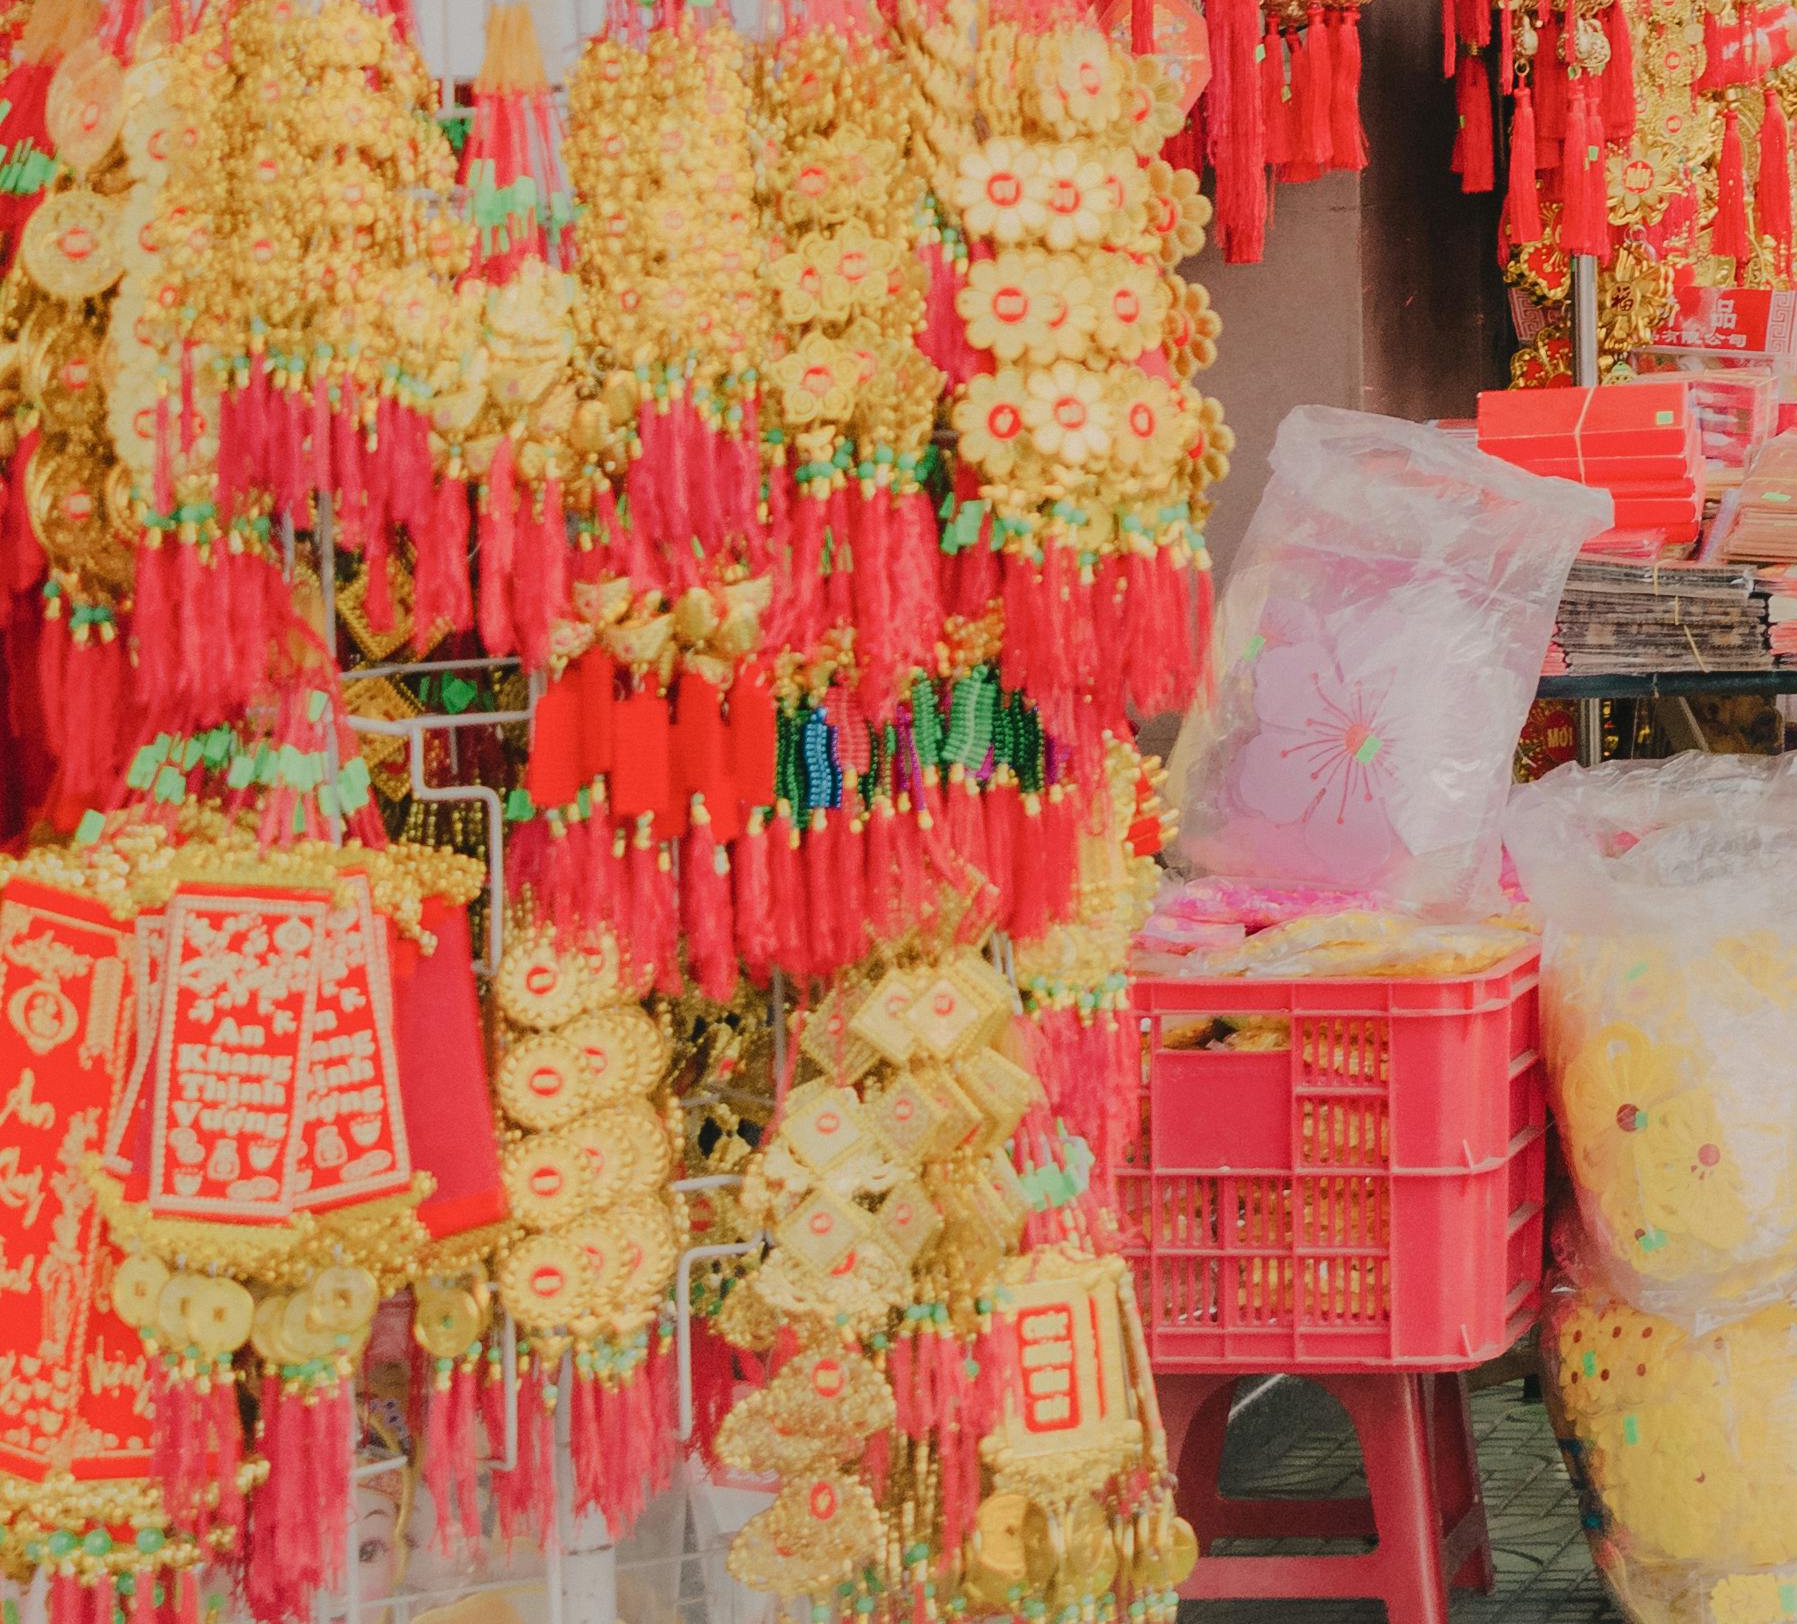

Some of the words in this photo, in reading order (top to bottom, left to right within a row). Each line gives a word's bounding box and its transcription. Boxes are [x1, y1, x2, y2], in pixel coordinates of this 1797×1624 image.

[211, 1016, 266, 1047] An
[311, 1028, 375, 1062] ang
[175, 1042, 293, 1082] Khang
[178, 1072, 286, 1107] Thịnh
[172, 1099, 289, 1141] Vượng
